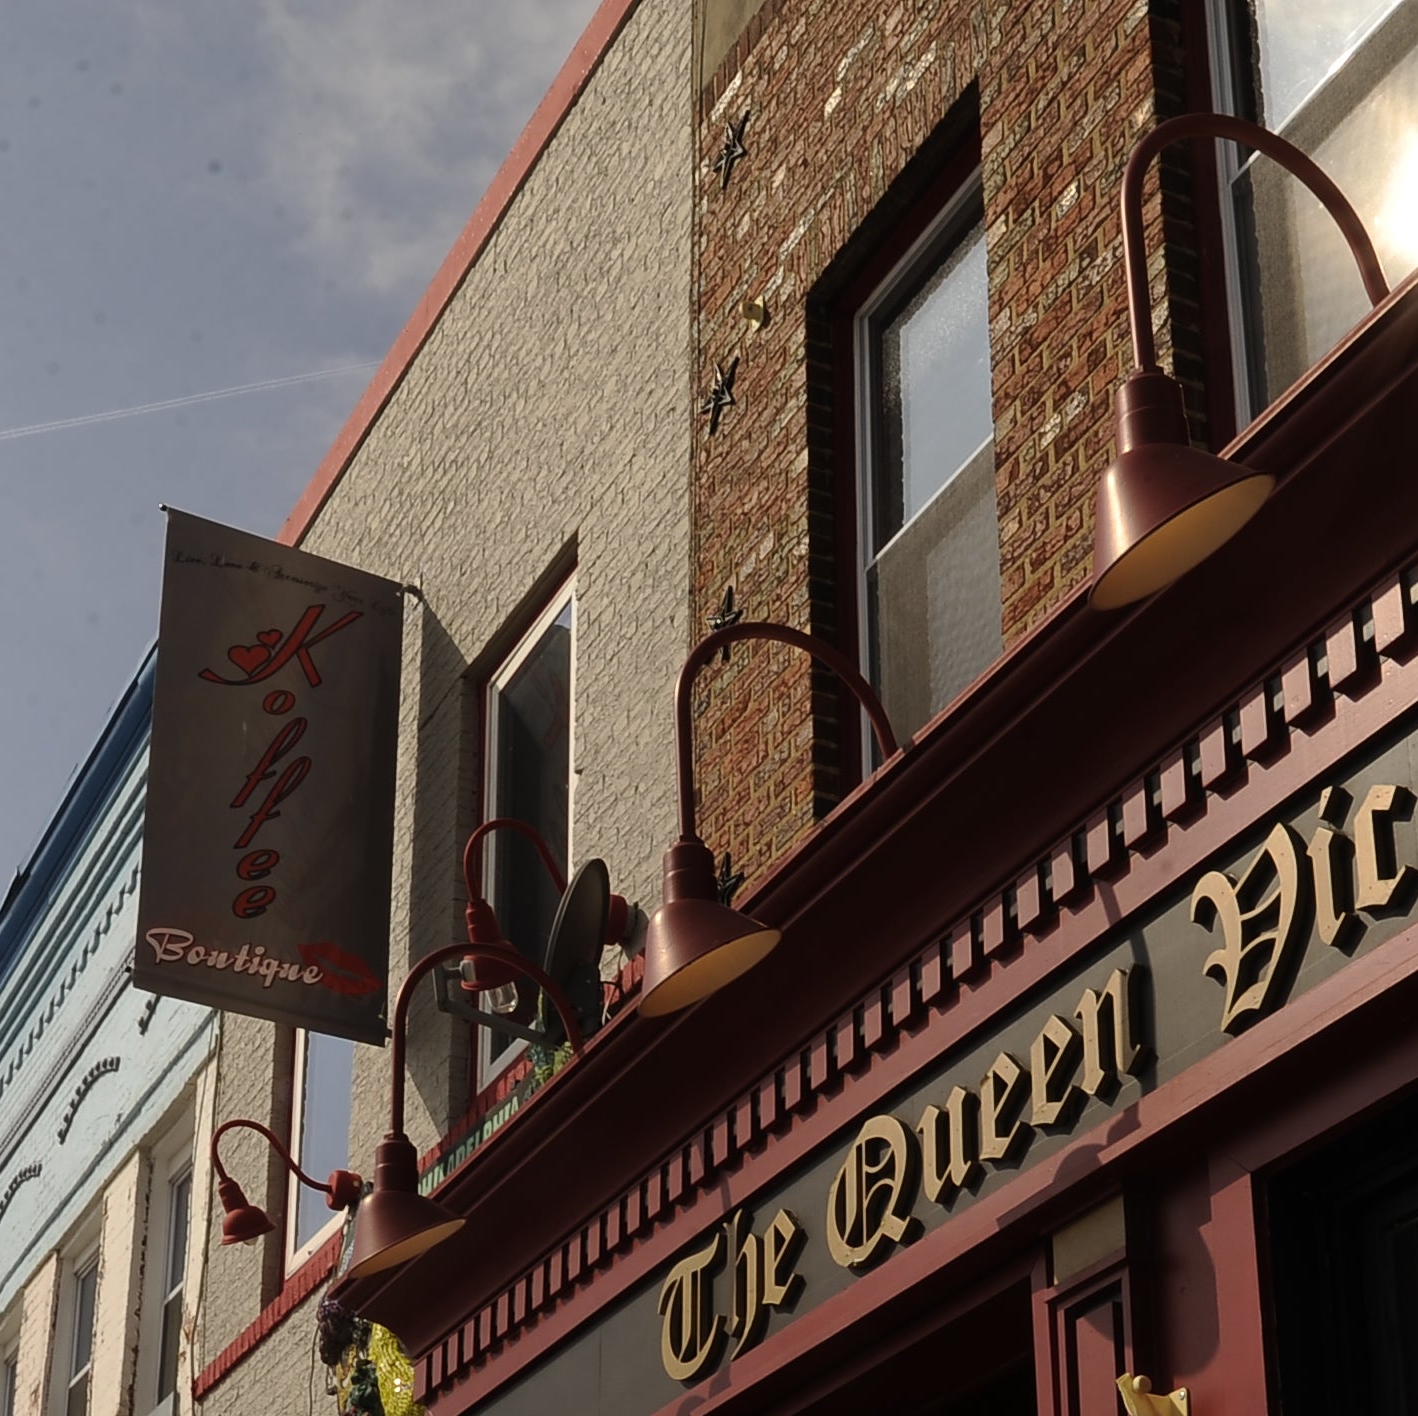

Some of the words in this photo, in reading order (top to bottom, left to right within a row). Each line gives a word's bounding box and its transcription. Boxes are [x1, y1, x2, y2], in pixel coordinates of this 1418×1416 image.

[198, 604, 363, 919] Koffee
[146, 928, 323, 988] Boutique
[418, 1095, 520, 1198] HILADELPHIA
[657, 1208, 805, 1381] The
[827, 962, 1158, 1268] Queen
